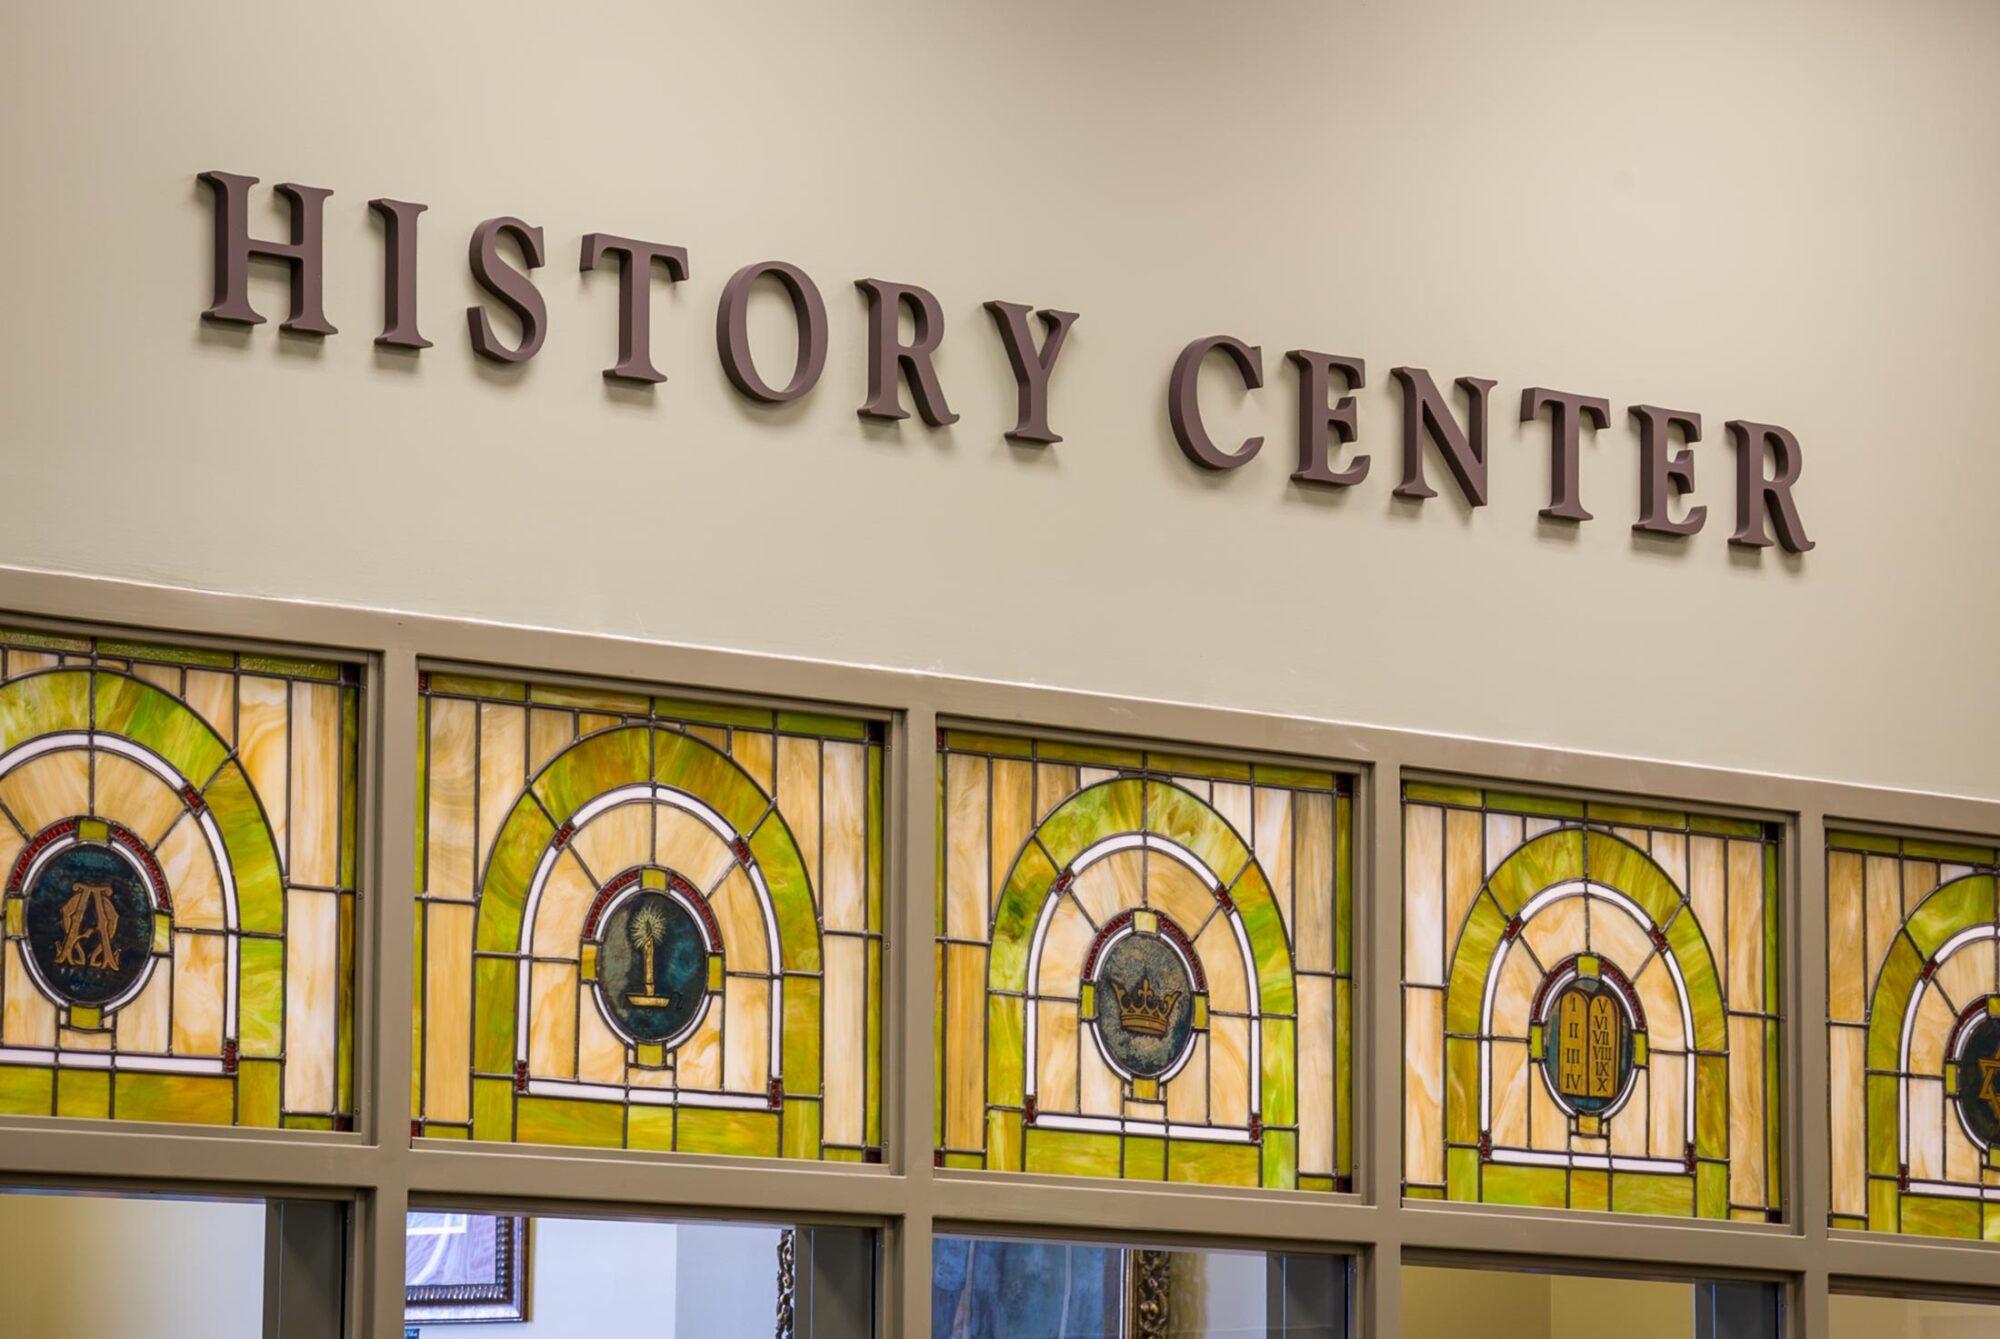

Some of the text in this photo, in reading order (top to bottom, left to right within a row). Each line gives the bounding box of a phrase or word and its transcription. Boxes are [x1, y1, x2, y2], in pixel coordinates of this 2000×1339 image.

[196, 170, 1815, 553] HISTORY CENTER
[1571, 997, 1577, 1012] I
[1597, 999, 1608, 1014] V
[1594, 1016, 1608, 1029] VI
[1569, 1023, 1579, 1038] II
[1592, 1030, 1609, 1045] VII
[1566, 1048, 1580, 1064] III
[1592, 1046, 1612, 1061] VIII
[1595, 1062, 1609, 1077] IX
[1565, 1073, 1581, 1090] IV
[1596, 1078, 1608, 1092] X
